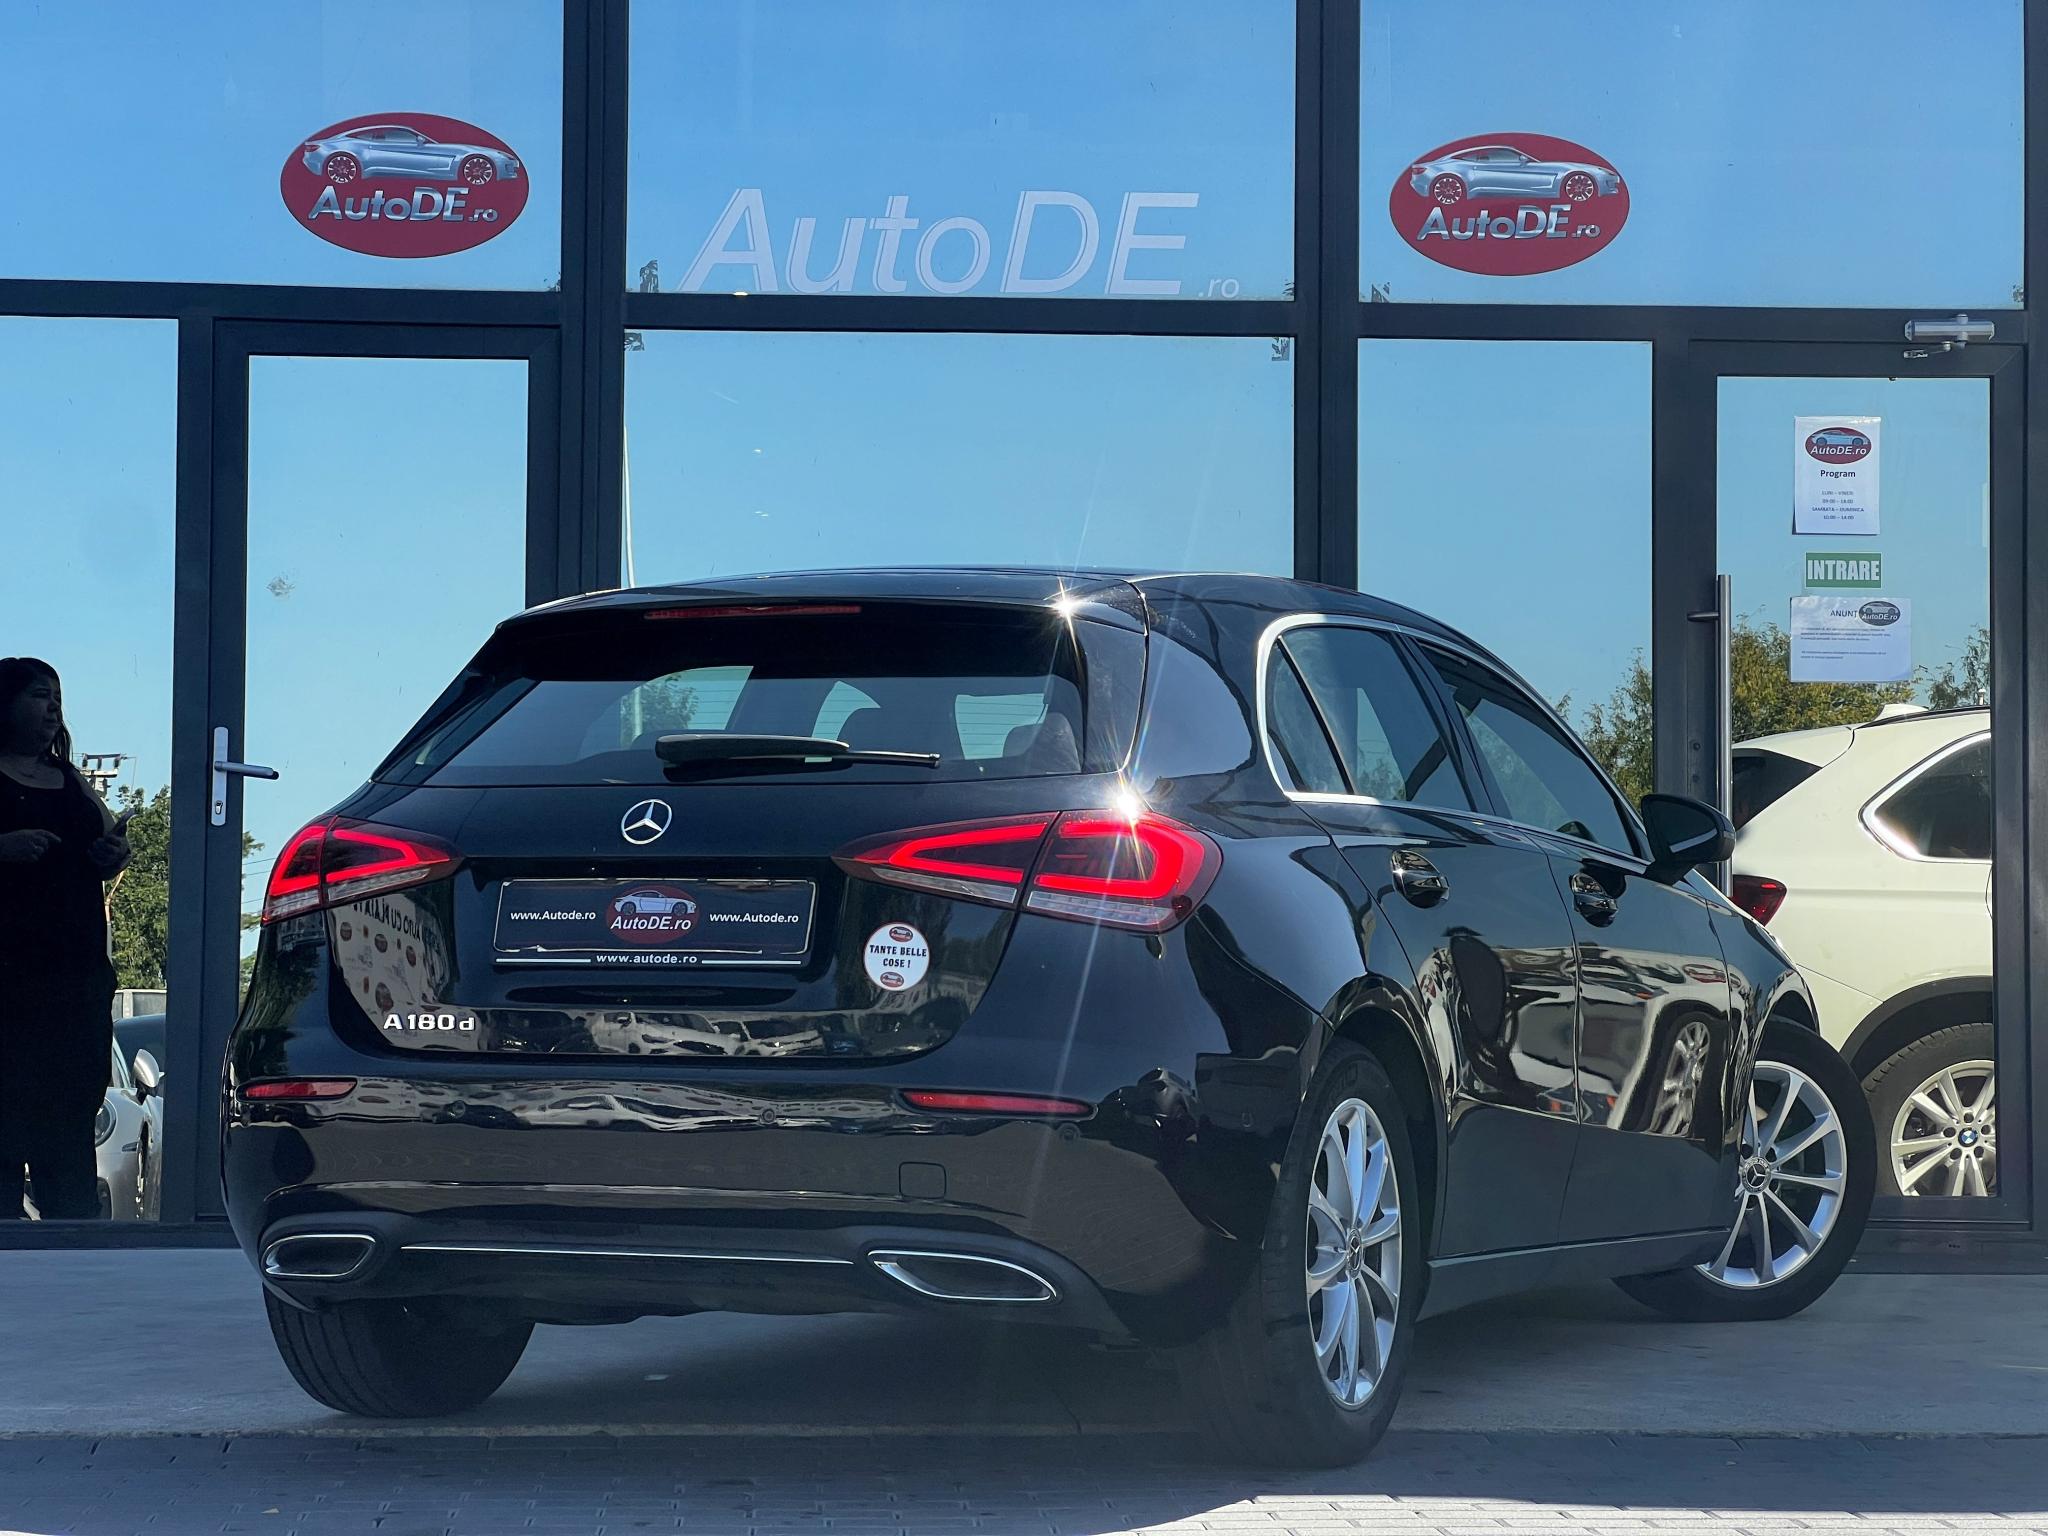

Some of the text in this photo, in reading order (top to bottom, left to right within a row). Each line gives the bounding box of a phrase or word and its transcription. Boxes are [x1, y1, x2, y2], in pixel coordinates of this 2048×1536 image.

[307, 185, 499, 222] AutoDE.ro
[1416, 203, 1602, 241] AutoDE.ro
[1810, 445, 1867, 456] AutoDE.ro
[1820, 469, 1856, 479] Program
[1807, 559, 1880, 581] INTRARE
[510, 909, 799, 931] www.Autode.ro AutoDE.ro www.Autode.ro
[869, 944, 927, 957] TANTE BELLE
[596, 953, 698, 964] www.autode.ro
[882, 957, 905, 968] COSE
[384, 1013, 475, 1031] A 180 d
